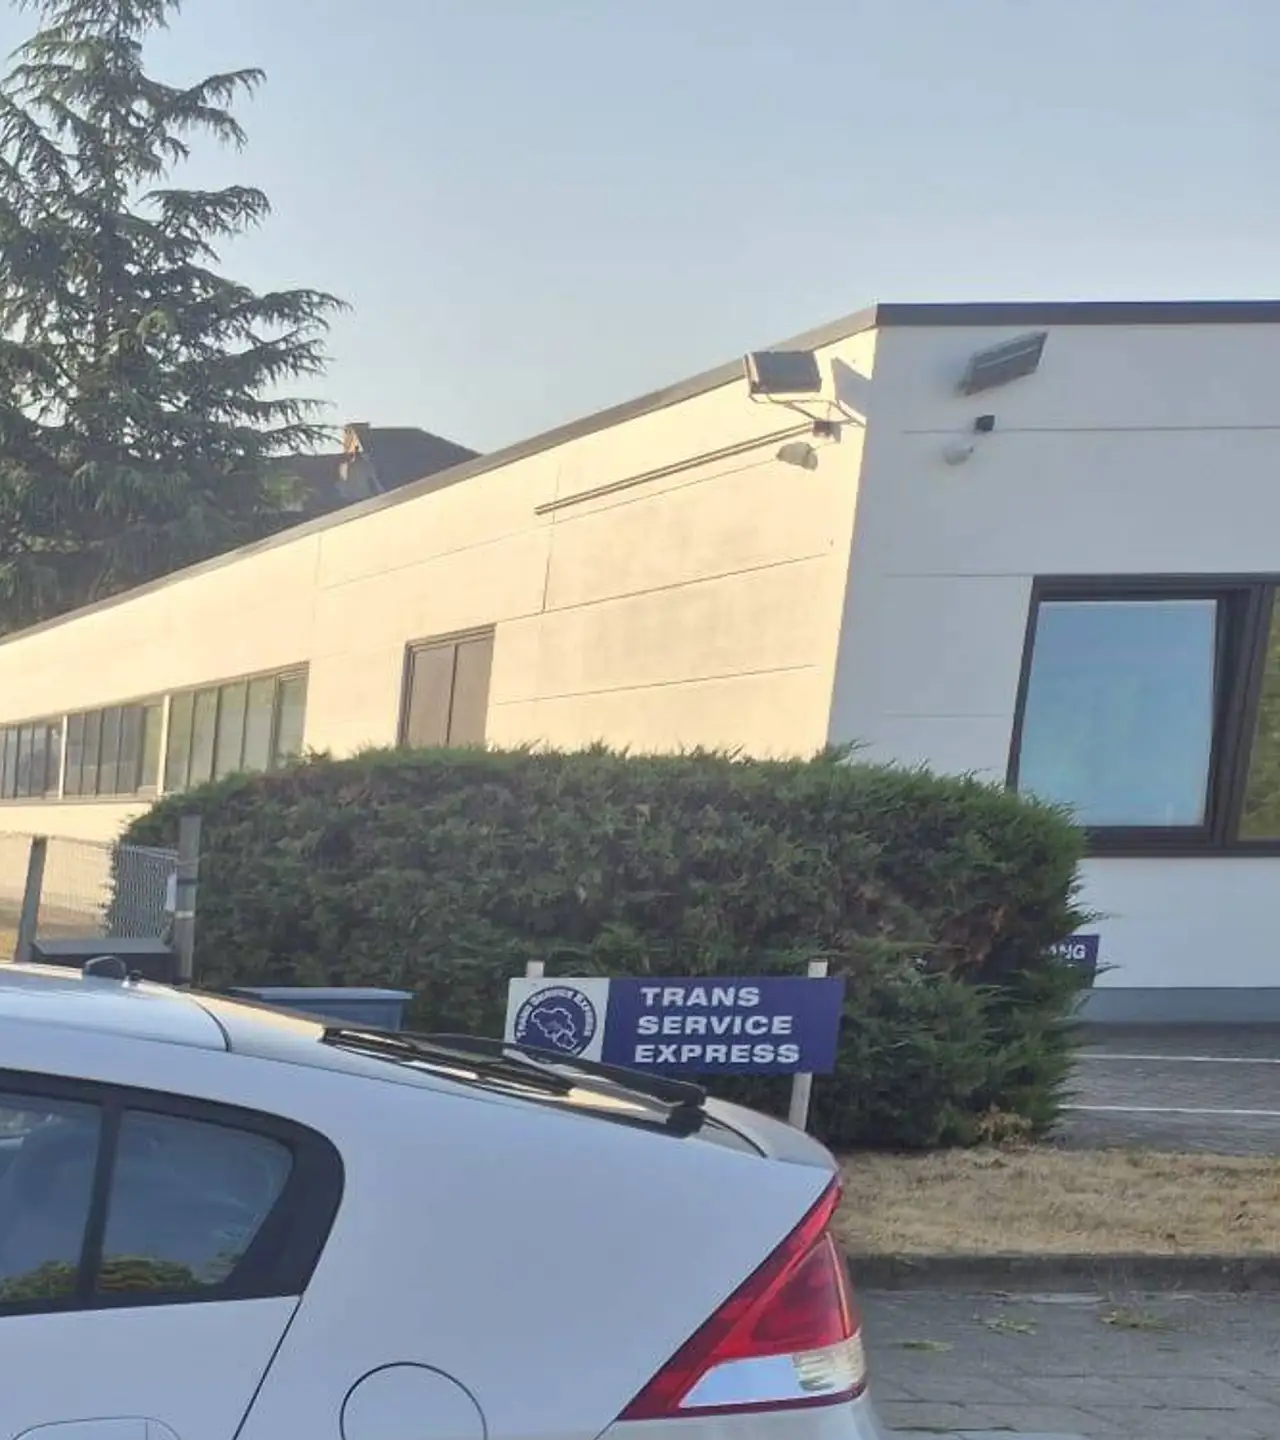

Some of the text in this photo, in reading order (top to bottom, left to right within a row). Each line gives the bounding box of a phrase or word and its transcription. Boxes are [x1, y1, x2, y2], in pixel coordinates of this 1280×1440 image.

[641, 986, 760, 1008] TRANS
[636, 1015, 793, 1036] SERVICE
[634, 1043, 801, 1064] EXPRESS
